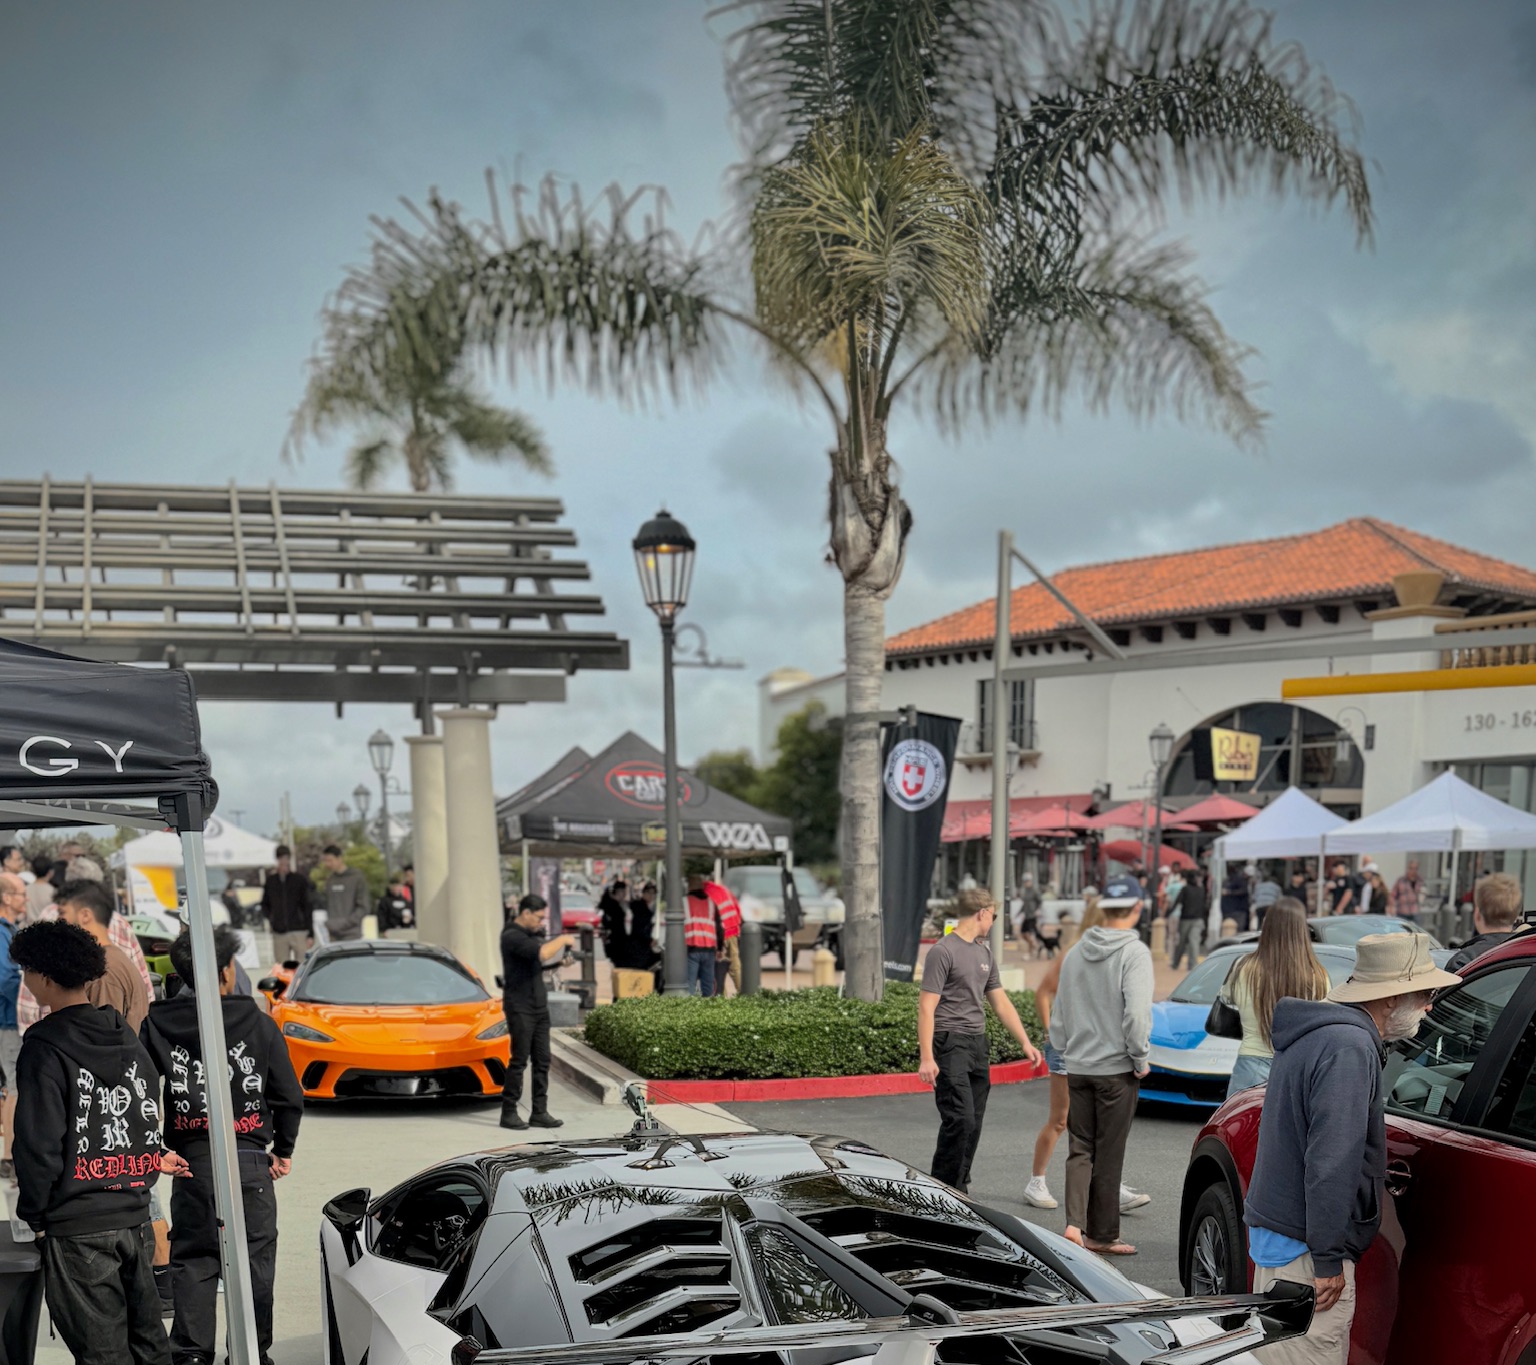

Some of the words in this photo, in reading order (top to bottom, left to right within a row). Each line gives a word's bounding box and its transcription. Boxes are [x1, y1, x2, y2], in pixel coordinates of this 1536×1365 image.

[1464, 713, 1496, 732] 130
[1511, 709, 1536, 729] 16
[616, 775, 667, 793] CAR
